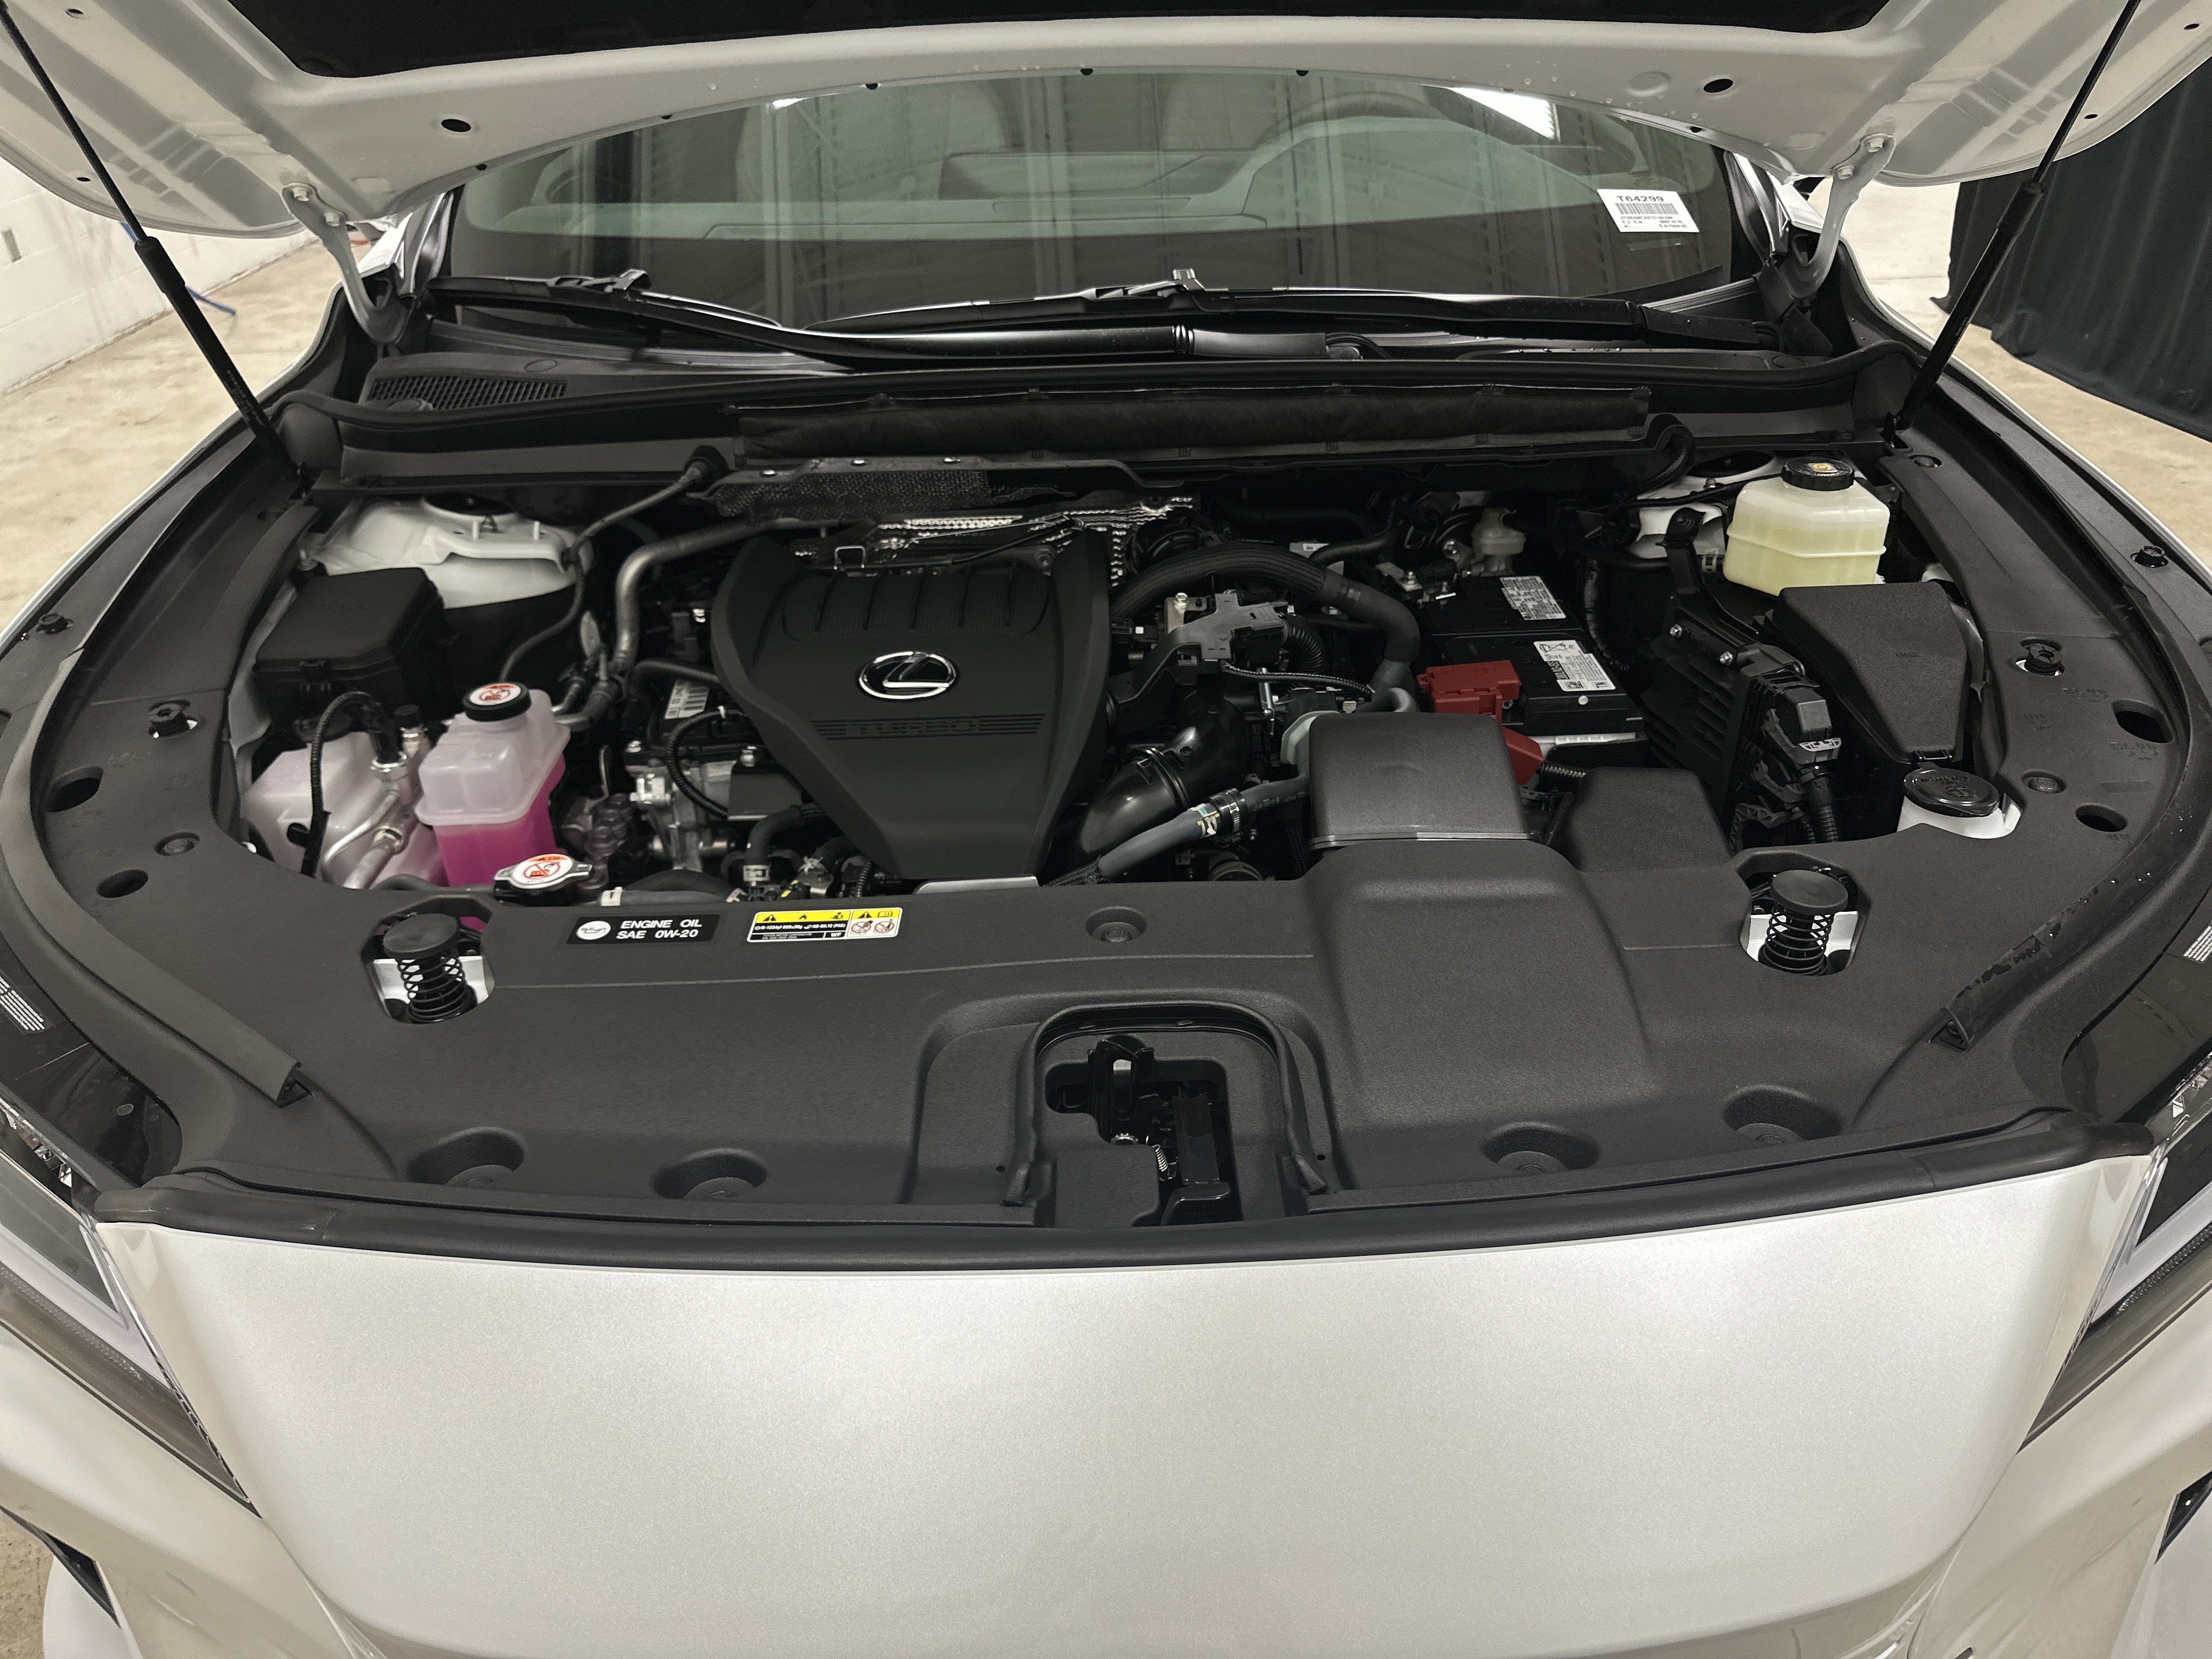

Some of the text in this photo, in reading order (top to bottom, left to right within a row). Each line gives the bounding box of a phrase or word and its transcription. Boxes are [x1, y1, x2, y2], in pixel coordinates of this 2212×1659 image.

[620, 919, 702, 929] ENGINE OIL
[616, 929, 698, 939] SAE 0W-20
